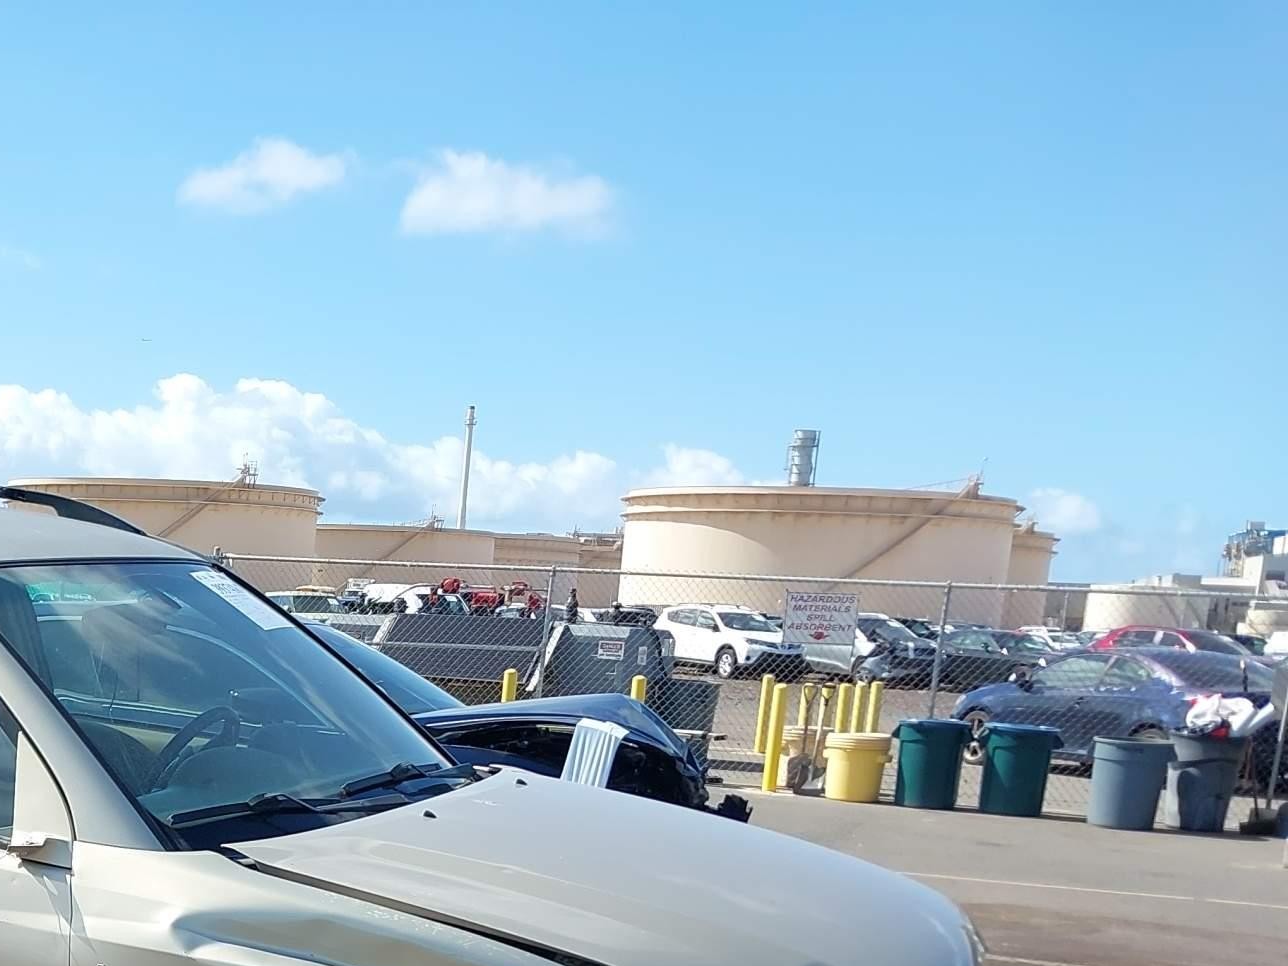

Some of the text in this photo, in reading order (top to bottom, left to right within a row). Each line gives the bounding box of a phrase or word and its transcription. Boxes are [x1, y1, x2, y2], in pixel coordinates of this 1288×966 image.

[790, 594, 856, 604] HAZARDOUS
[792, 604, 852, 613] MATERIALS
[806, 613, 835, 622] SPILL
[787, 622, 853, 632] ABSORBENT
